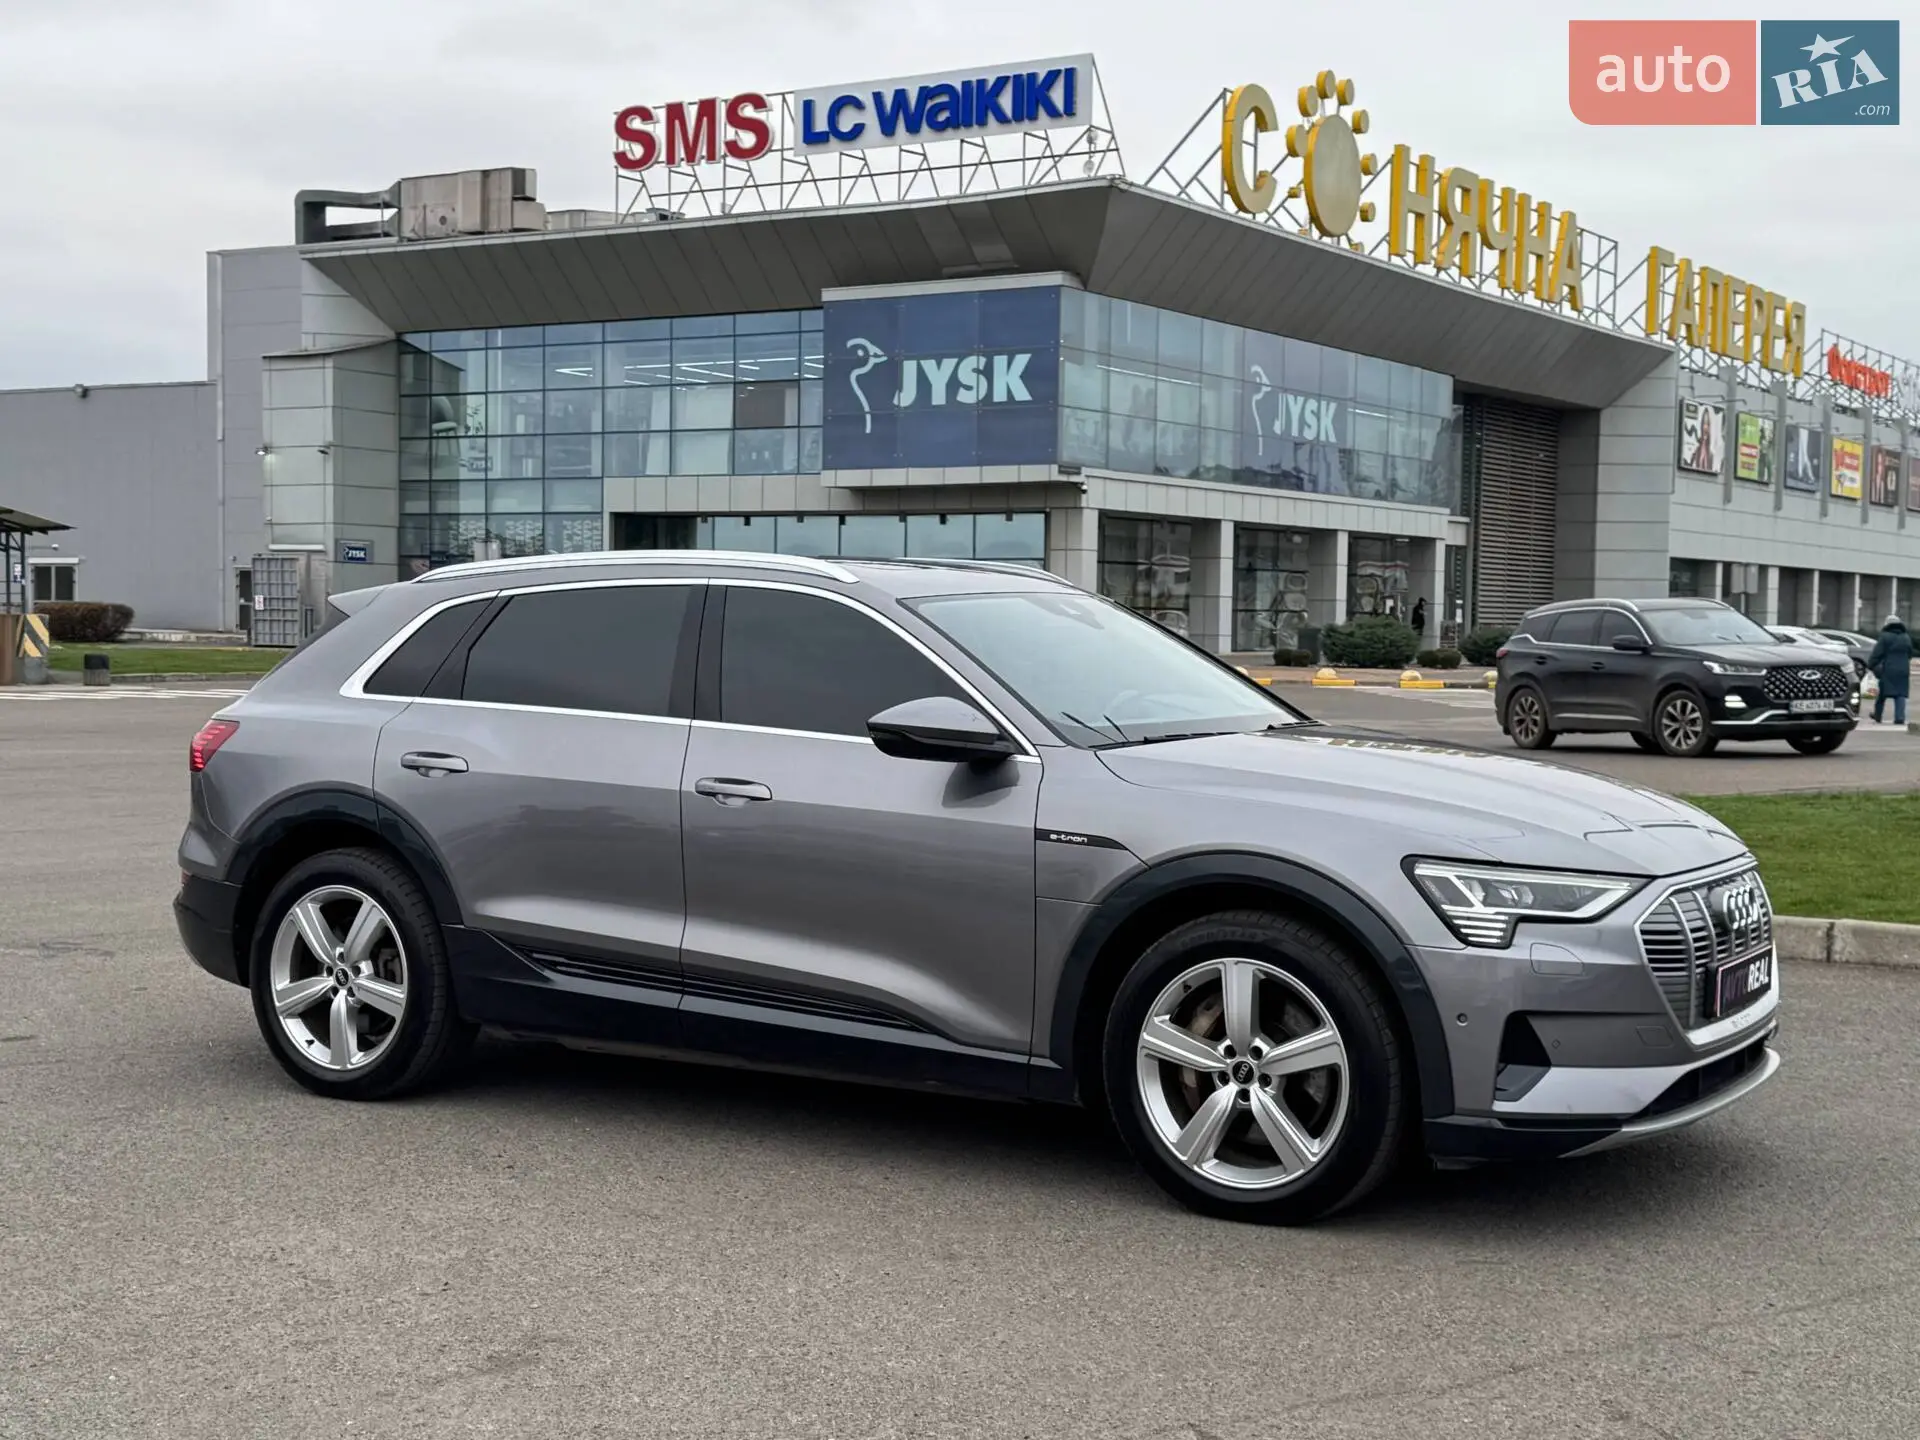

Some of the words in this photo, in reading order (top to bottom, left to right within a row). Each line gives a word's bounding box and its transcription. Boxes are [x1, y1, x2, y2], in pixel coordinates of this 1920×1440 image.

[613, 91, 773, 172] SMS
[801, 94, 868, 146] LC
[1645, 245, 1807, 380] ГАЛЕРЕЯ
[893, 353, 1033, 407] JYSK
[1273, 392, 1338, 443] JYSK
[1050, 833, 1087, 843] e-tron
